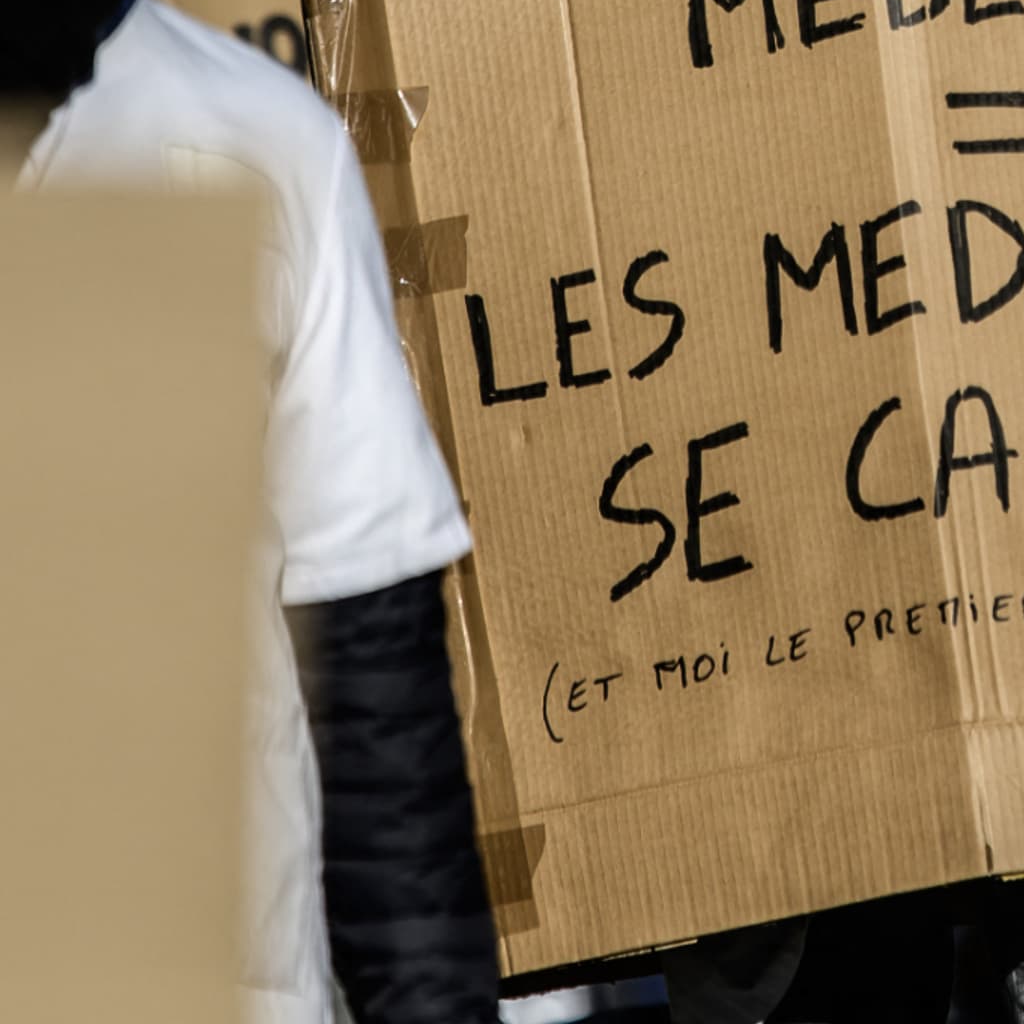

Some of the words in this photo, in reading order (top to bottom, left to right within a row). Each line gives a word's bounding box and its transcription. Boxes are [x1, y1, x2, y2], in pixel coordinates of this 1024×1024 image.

[465, 249, 685, 406] LES
[599, 421, 754, 602] SE
[542, 662, 623, 742] (ET
[765, 628, 812, 667] LE
